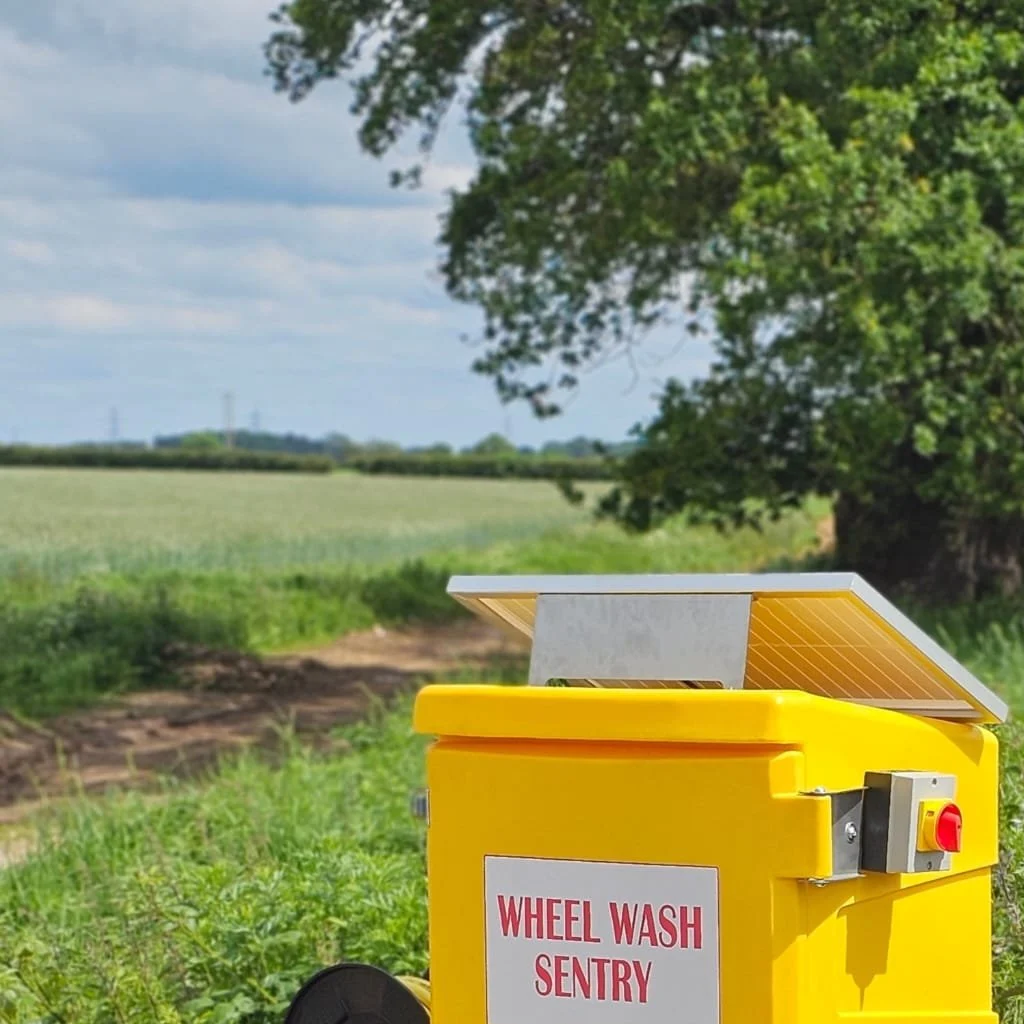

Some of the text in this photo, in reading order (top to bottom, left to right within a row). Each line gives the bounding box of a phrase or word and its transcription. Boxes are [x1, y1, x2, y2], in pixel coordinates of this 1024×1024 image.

[497, 894, 702, 949] WHEEL WASH
[535, 953, 652, 1003] SENTRY
